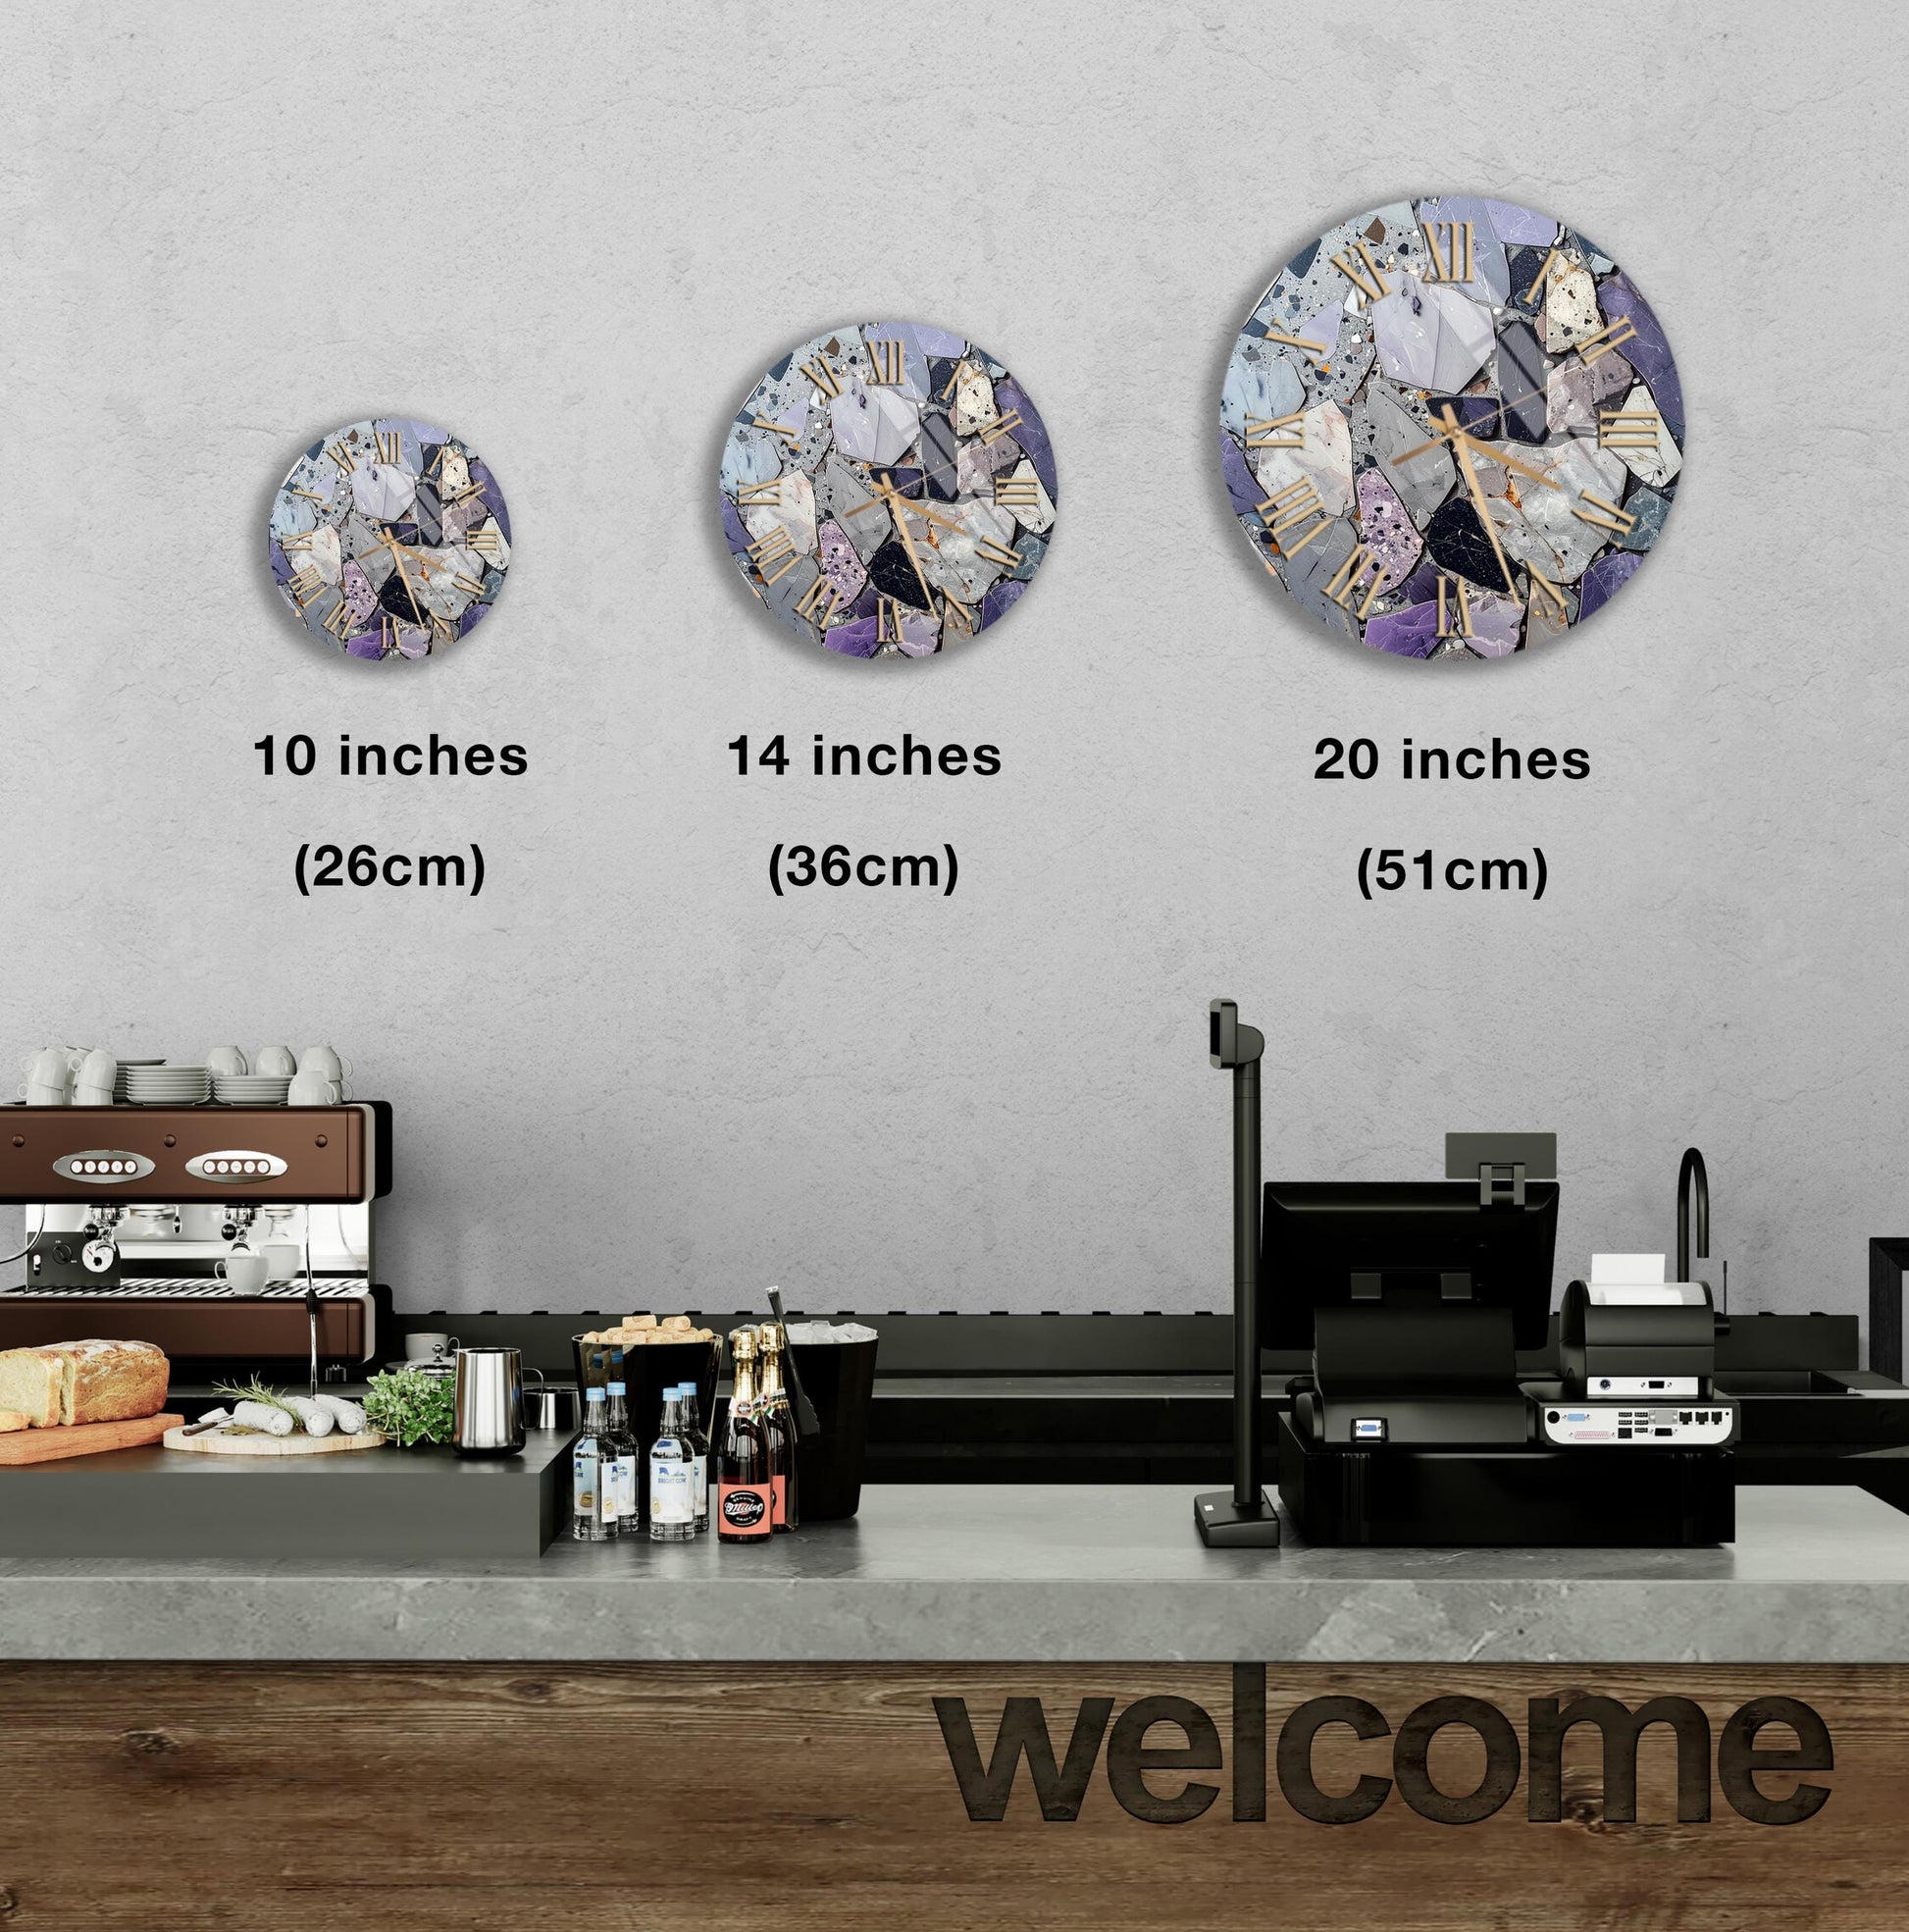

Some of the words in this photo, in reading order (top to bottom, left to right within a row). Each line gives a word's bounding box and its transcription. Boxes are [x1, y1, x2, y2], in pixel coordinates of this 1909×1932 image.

[1328, 240, 1393, 311] XI
[1422, 221, 1473, 283] XII
[1522, 248, 1560, 306] I
[867, 340, 903, 385] XII
[1574, 314, 1638, 367] II
[941, 361, 966, 400] I
[979, 409, 1023, 445] II
[1244, 410, 1307, 449] IX
[1598, 409, 1660, 449] III
[996, 479, 1038, 505] III
[1255, 475, 1325, 561] VIII
[1571, 488, 1638, 549] IV
[1320, 542, 1389, 621] VII
[1435, 575, 1472, 638] VI
[931, 1662, 1834, 1826] welcome
